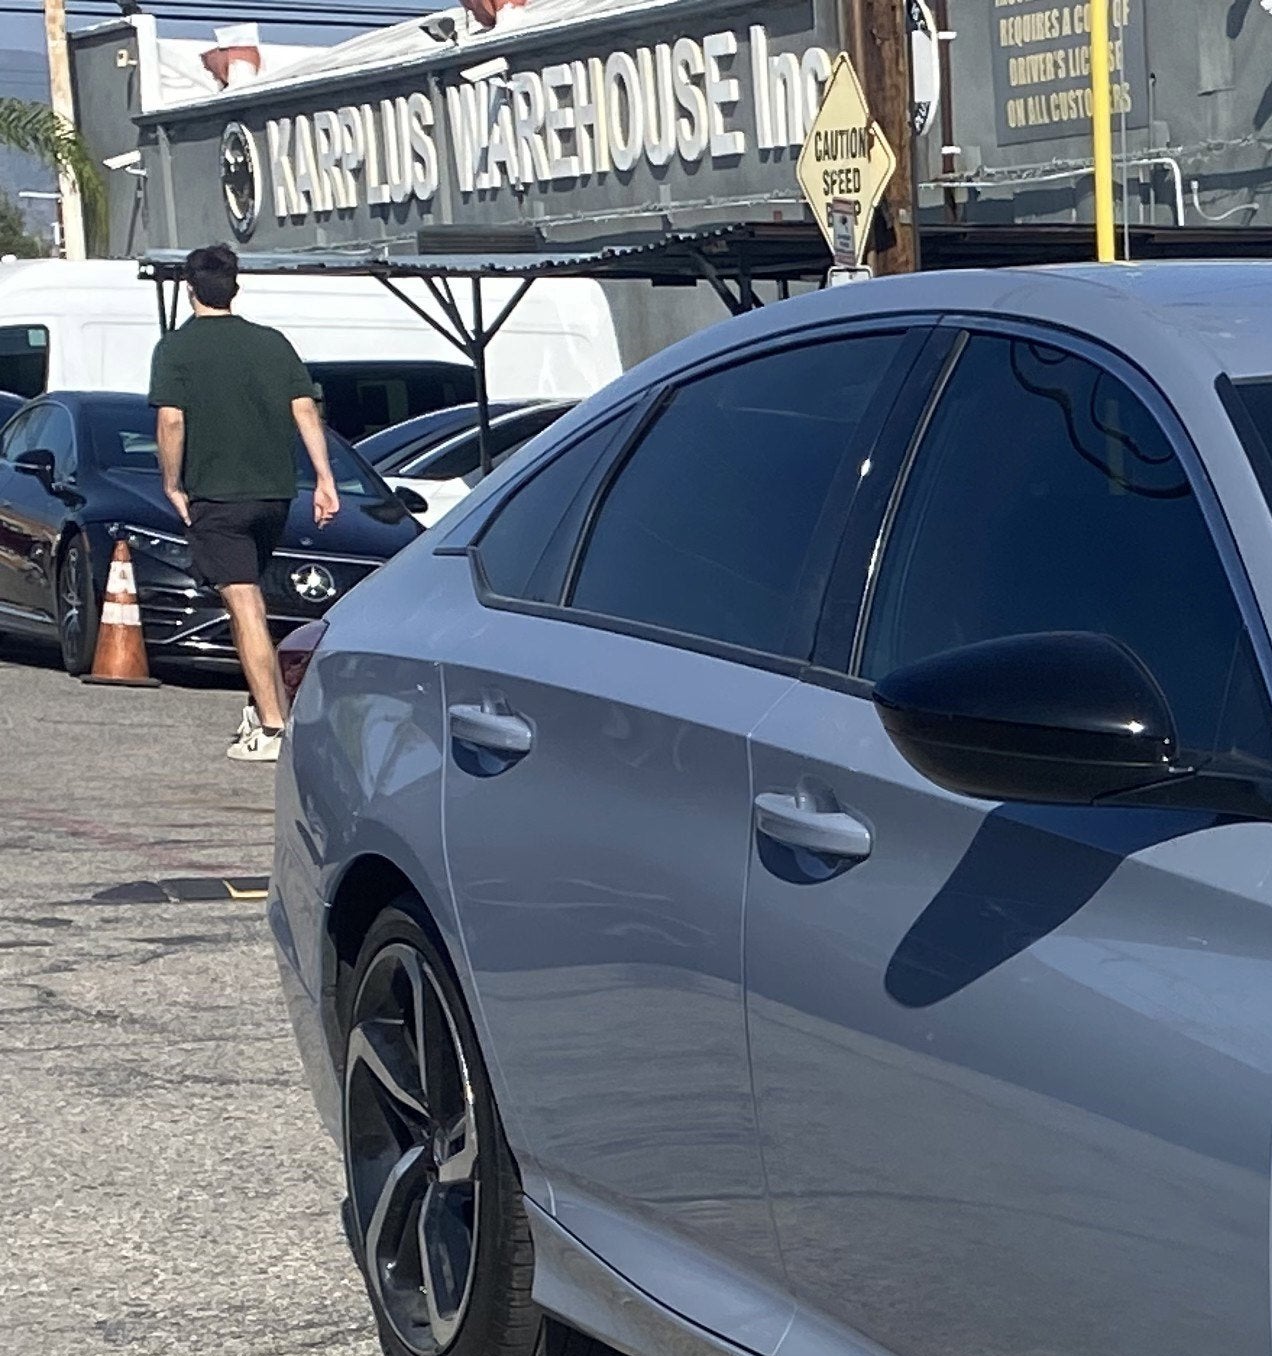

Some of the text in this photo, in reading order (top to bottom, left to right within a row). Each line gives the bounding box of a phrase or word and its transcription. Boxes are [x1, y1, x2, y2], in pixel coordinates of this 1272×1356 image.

[1000, 8, 1060, 47] REQUIRES
[1062, 7, 1072, 36] A
[1009, 40, 1123, 87] DRIVER'S LICSE
[266, 93, 438, 217] KARPLUS
[446, 31, 745, 191] WAREHOUSE
[1007, 82, 1132, 128] ON ALL CUSTORS
[814, 127, 867, 162] CAUTION
[822, 168, 861, 196] SPEED
